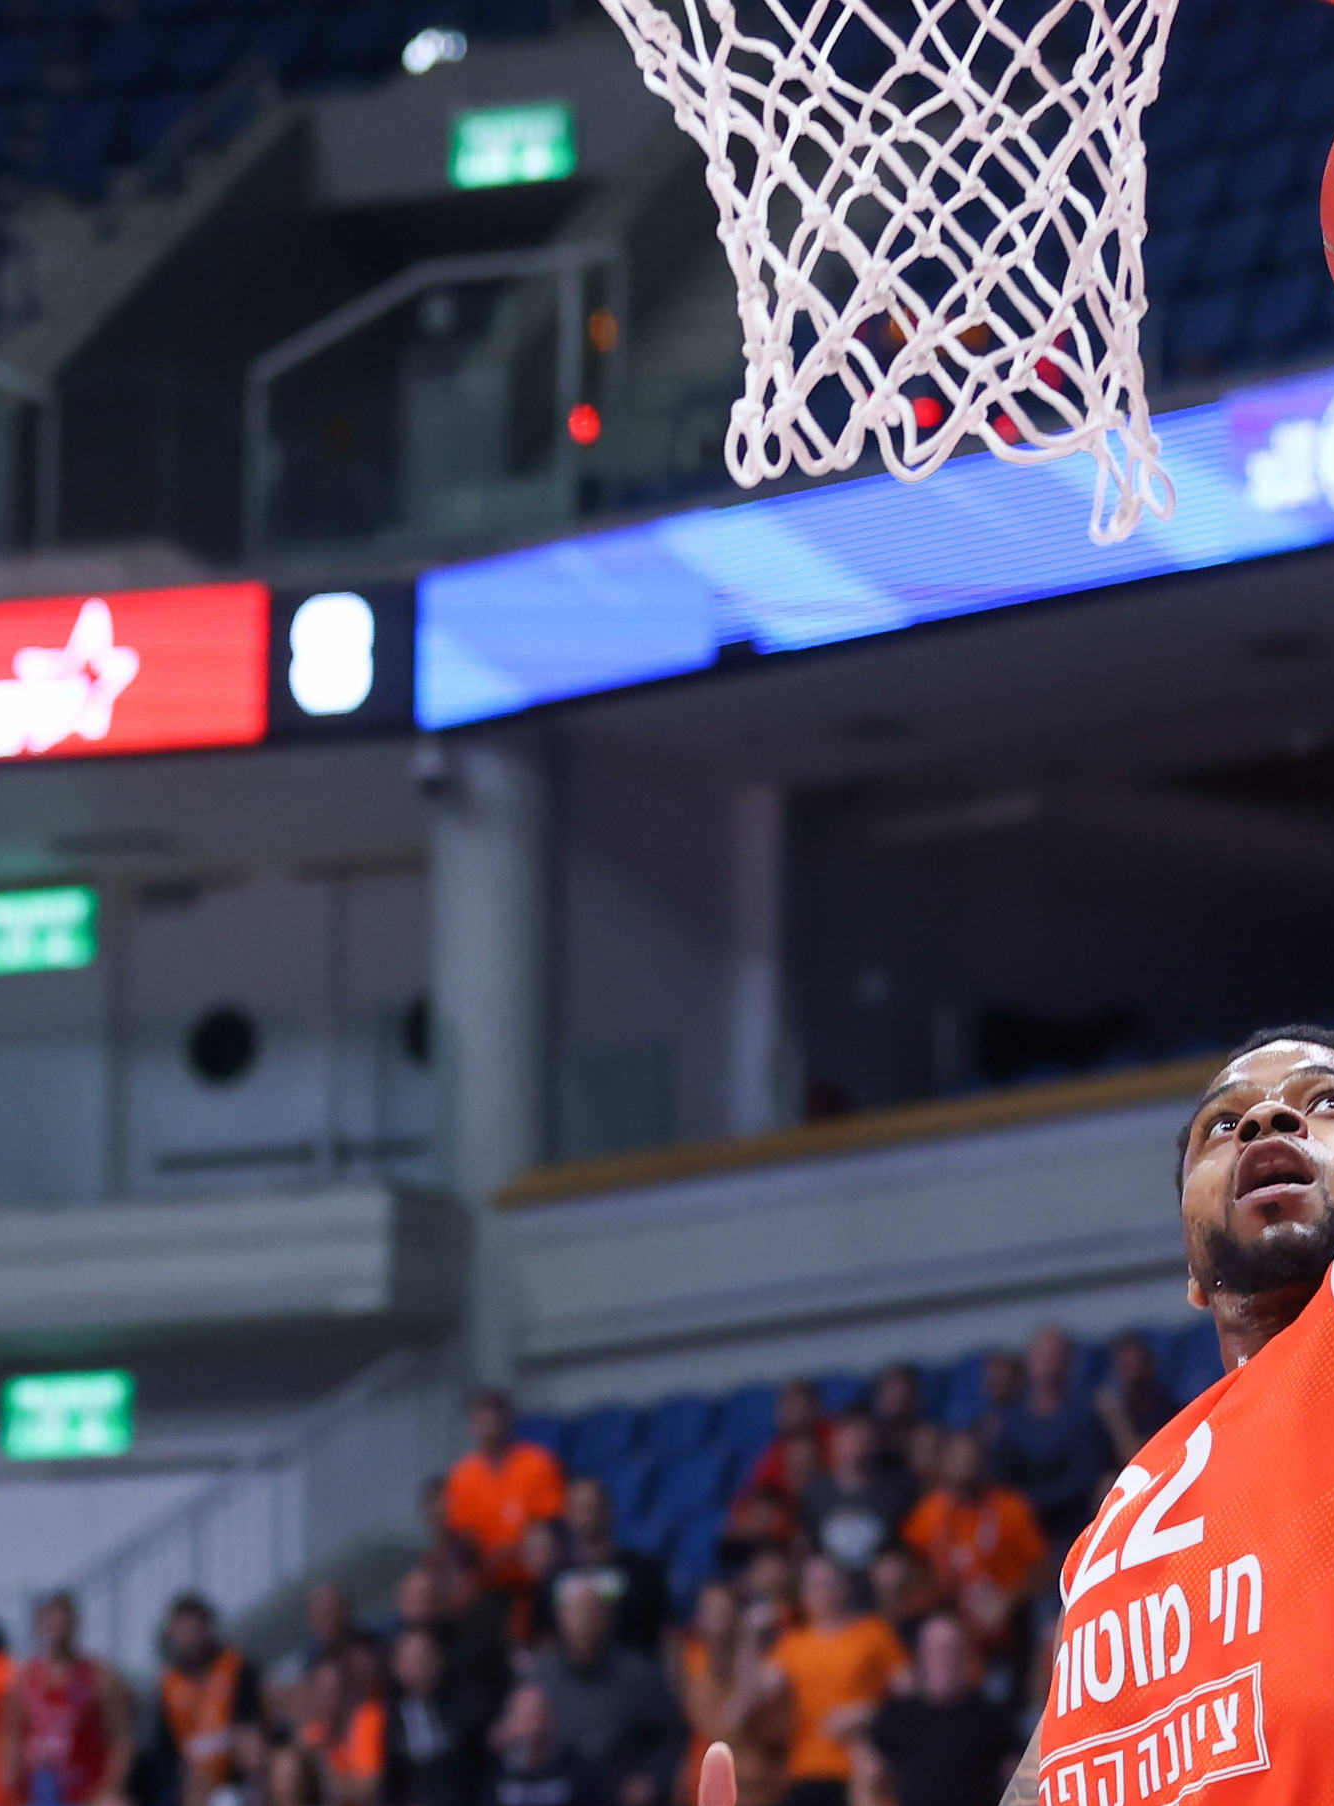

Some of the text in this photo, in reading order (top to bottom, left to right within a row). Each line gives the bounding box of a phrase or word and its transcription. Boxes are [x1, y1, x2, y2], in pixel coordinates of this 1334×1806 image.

[1059, 1420, 1213, 1616] 22
[1209, 1553, 1263, 1646] חי
[1137, 1692, 1240, 1800] ציונה
